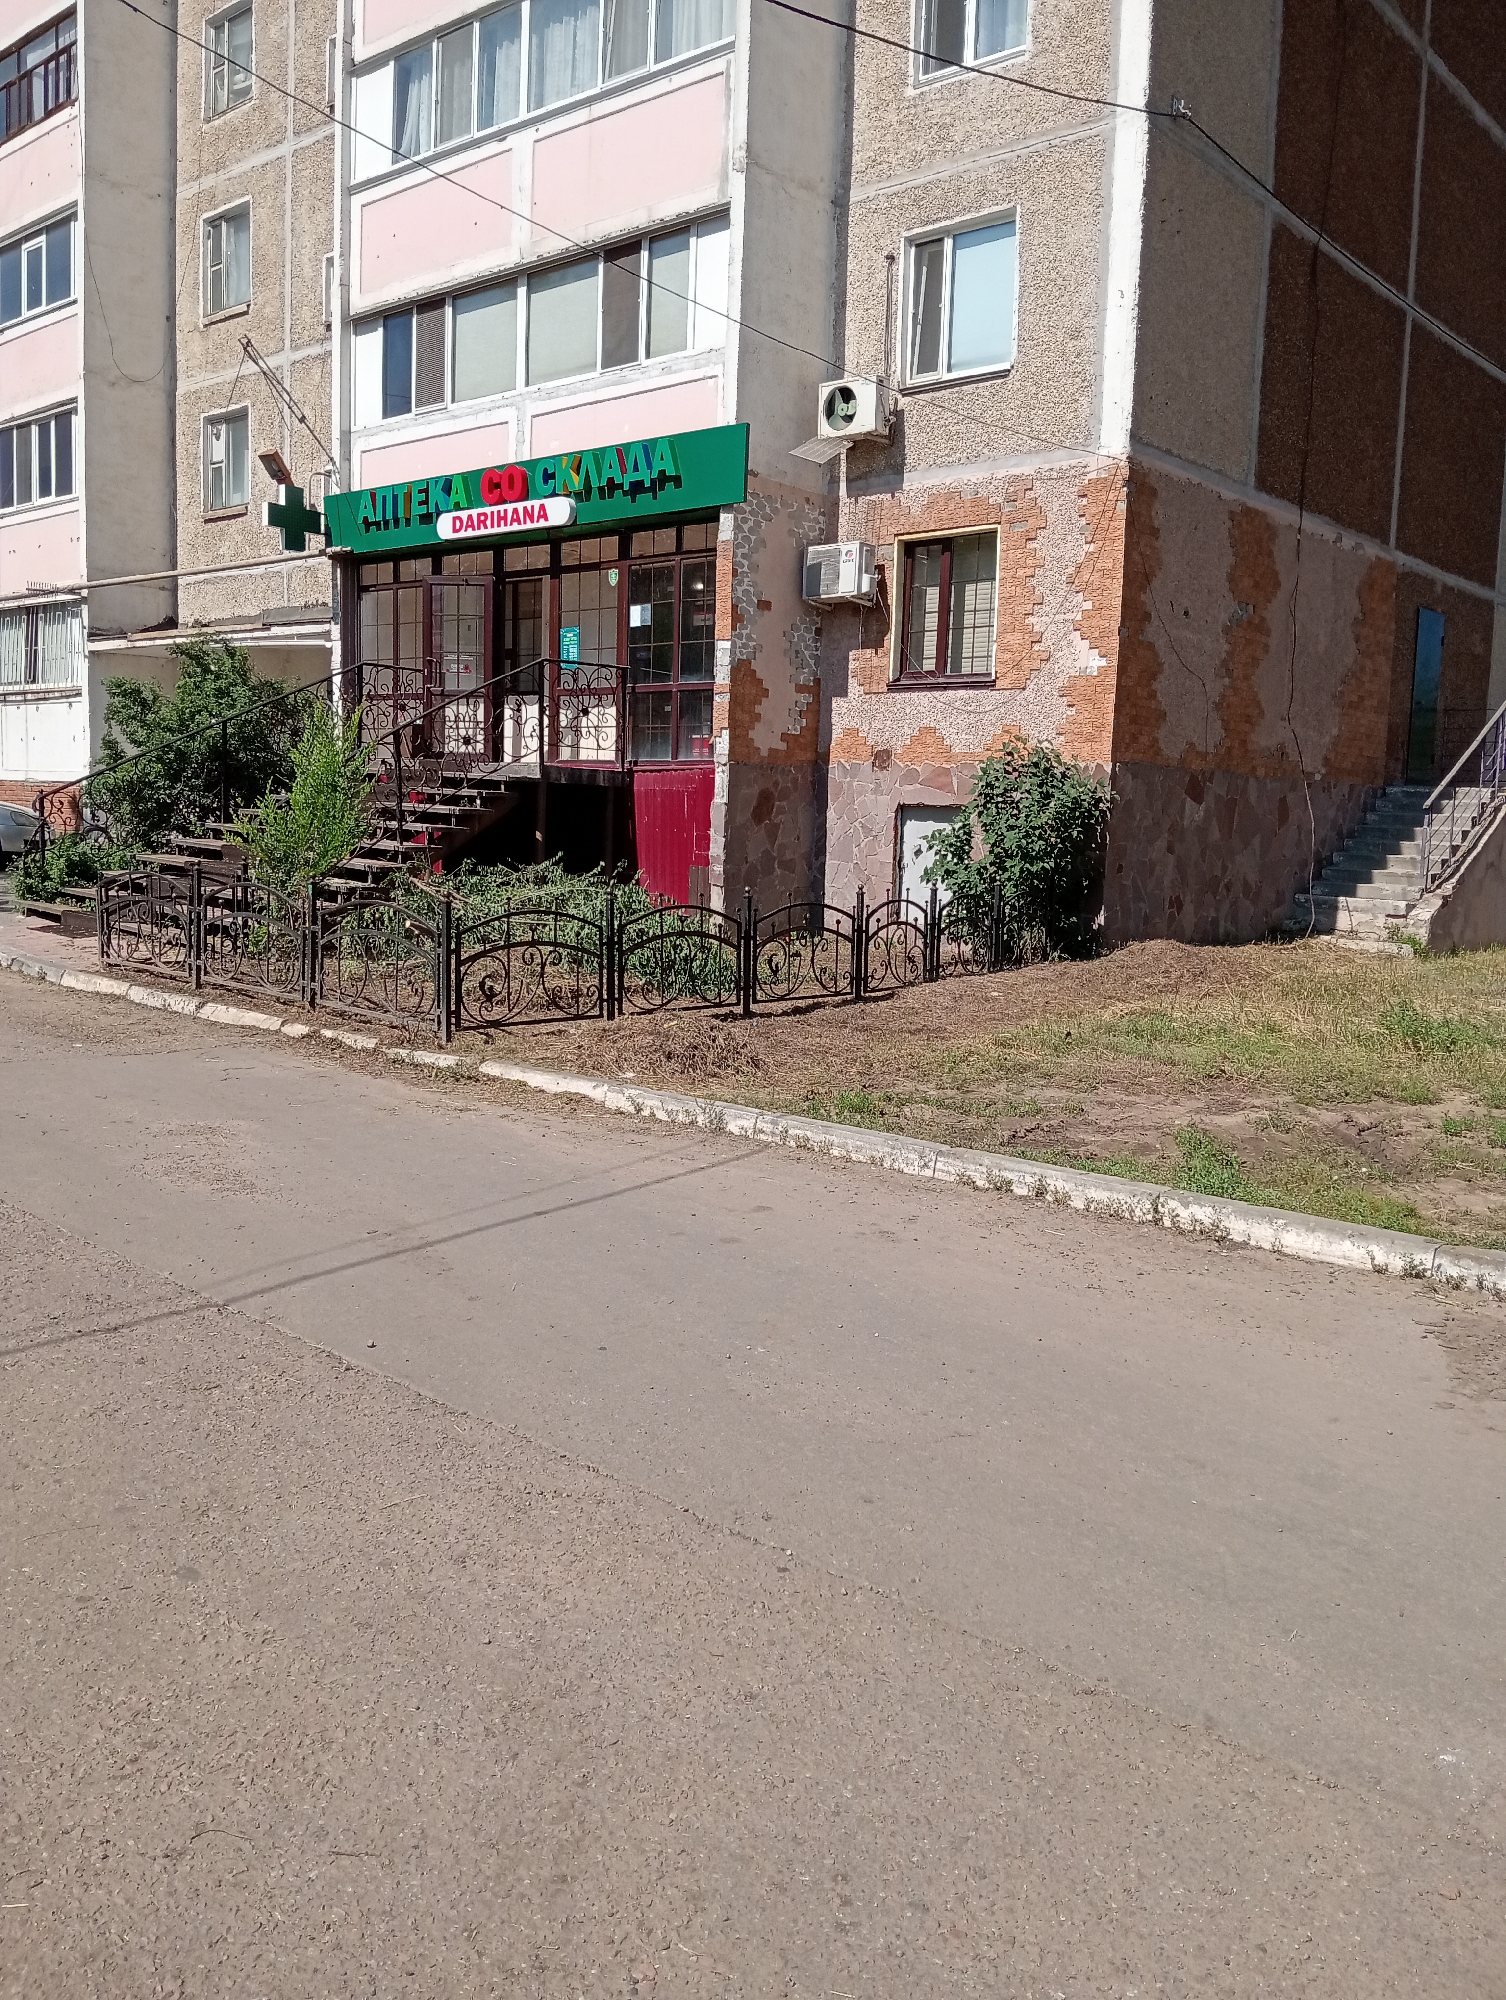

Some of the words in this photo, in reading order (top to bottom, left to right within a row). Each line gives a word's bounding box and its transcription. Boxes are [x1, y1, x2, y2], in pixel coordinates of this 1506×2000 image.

[358, 474, 470, 524] АПТЕКА
[479, 464, 529, 505] СО
[535, 438, 679, 496] СКЛАДА
[452, 503, 549, 534] DARIHANA
